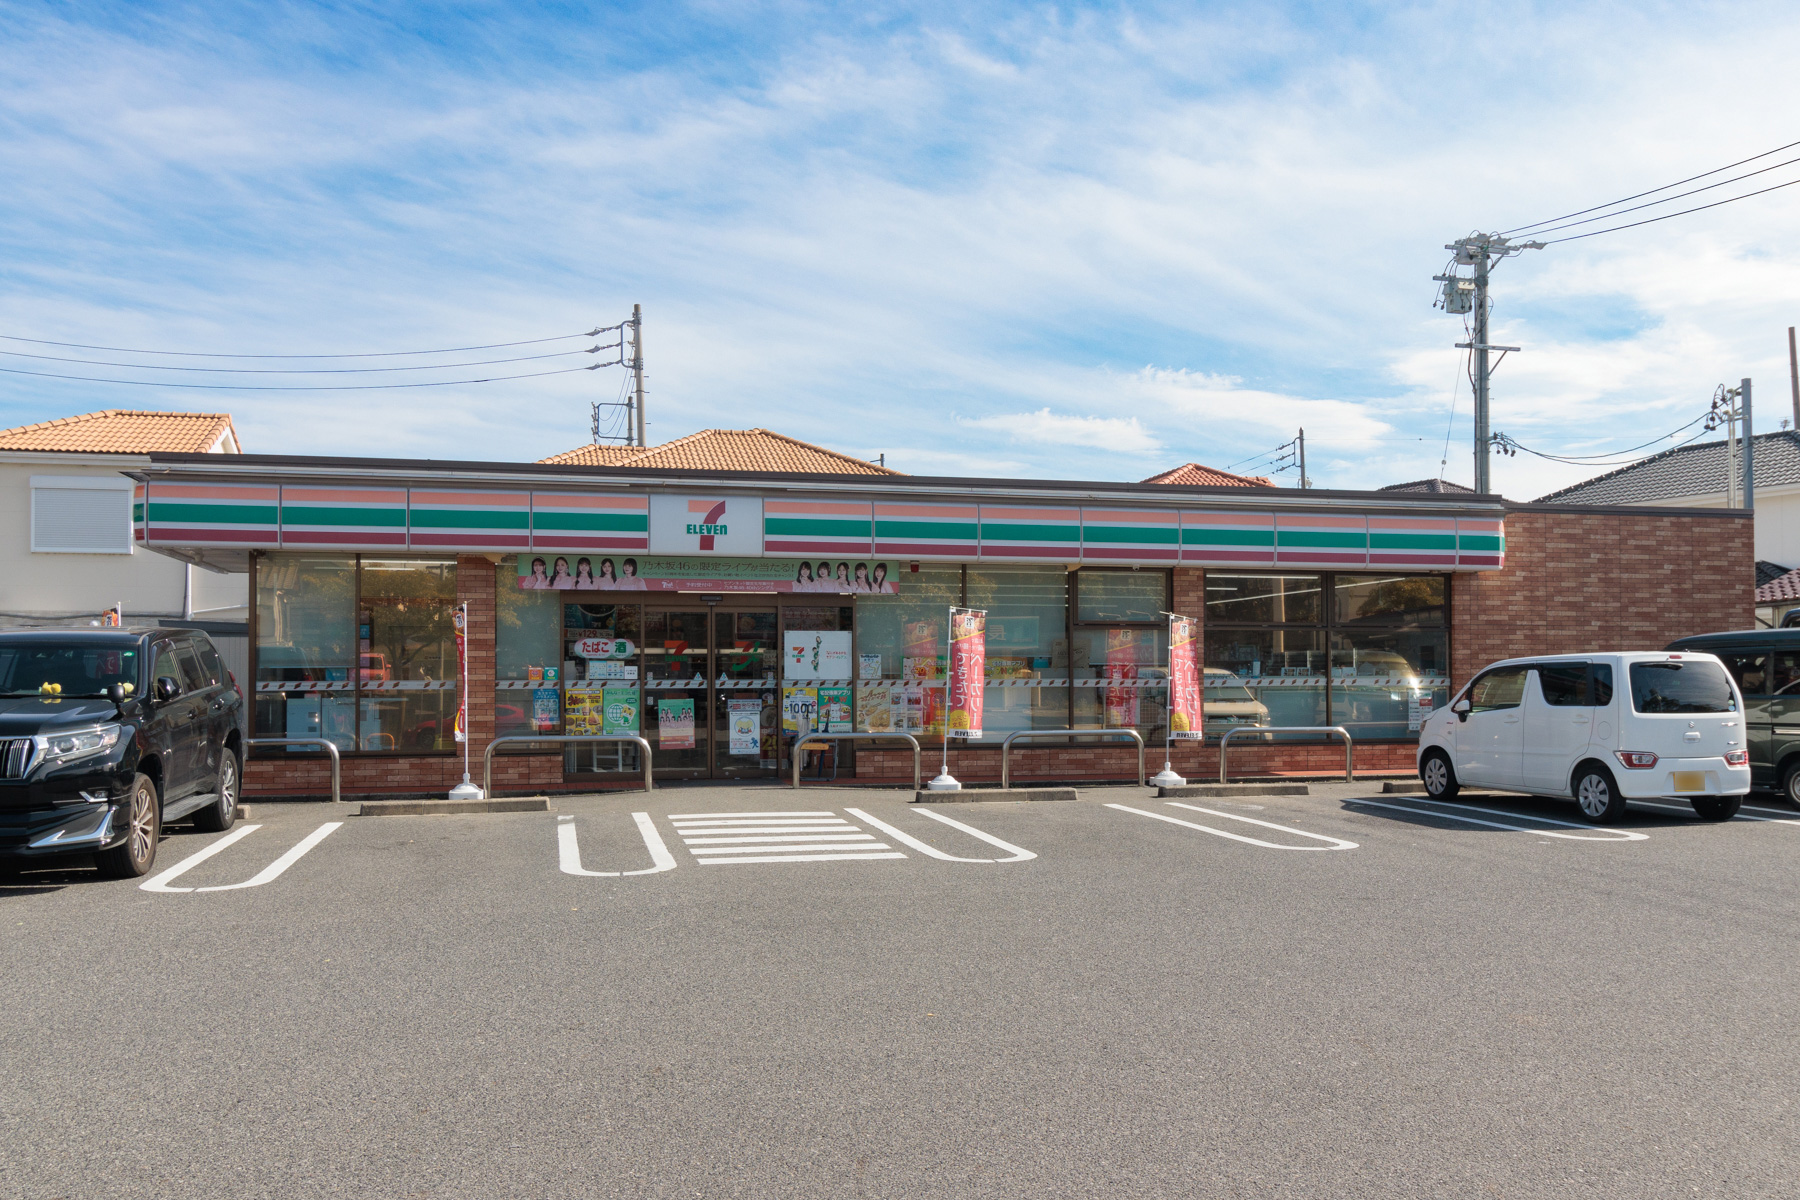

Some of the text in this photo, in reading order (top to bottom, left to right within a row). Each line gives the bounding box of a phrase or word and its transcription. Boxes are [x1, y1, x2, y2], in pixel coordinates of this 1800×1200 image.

[582, 641, 627, 654] たばこ 酒
